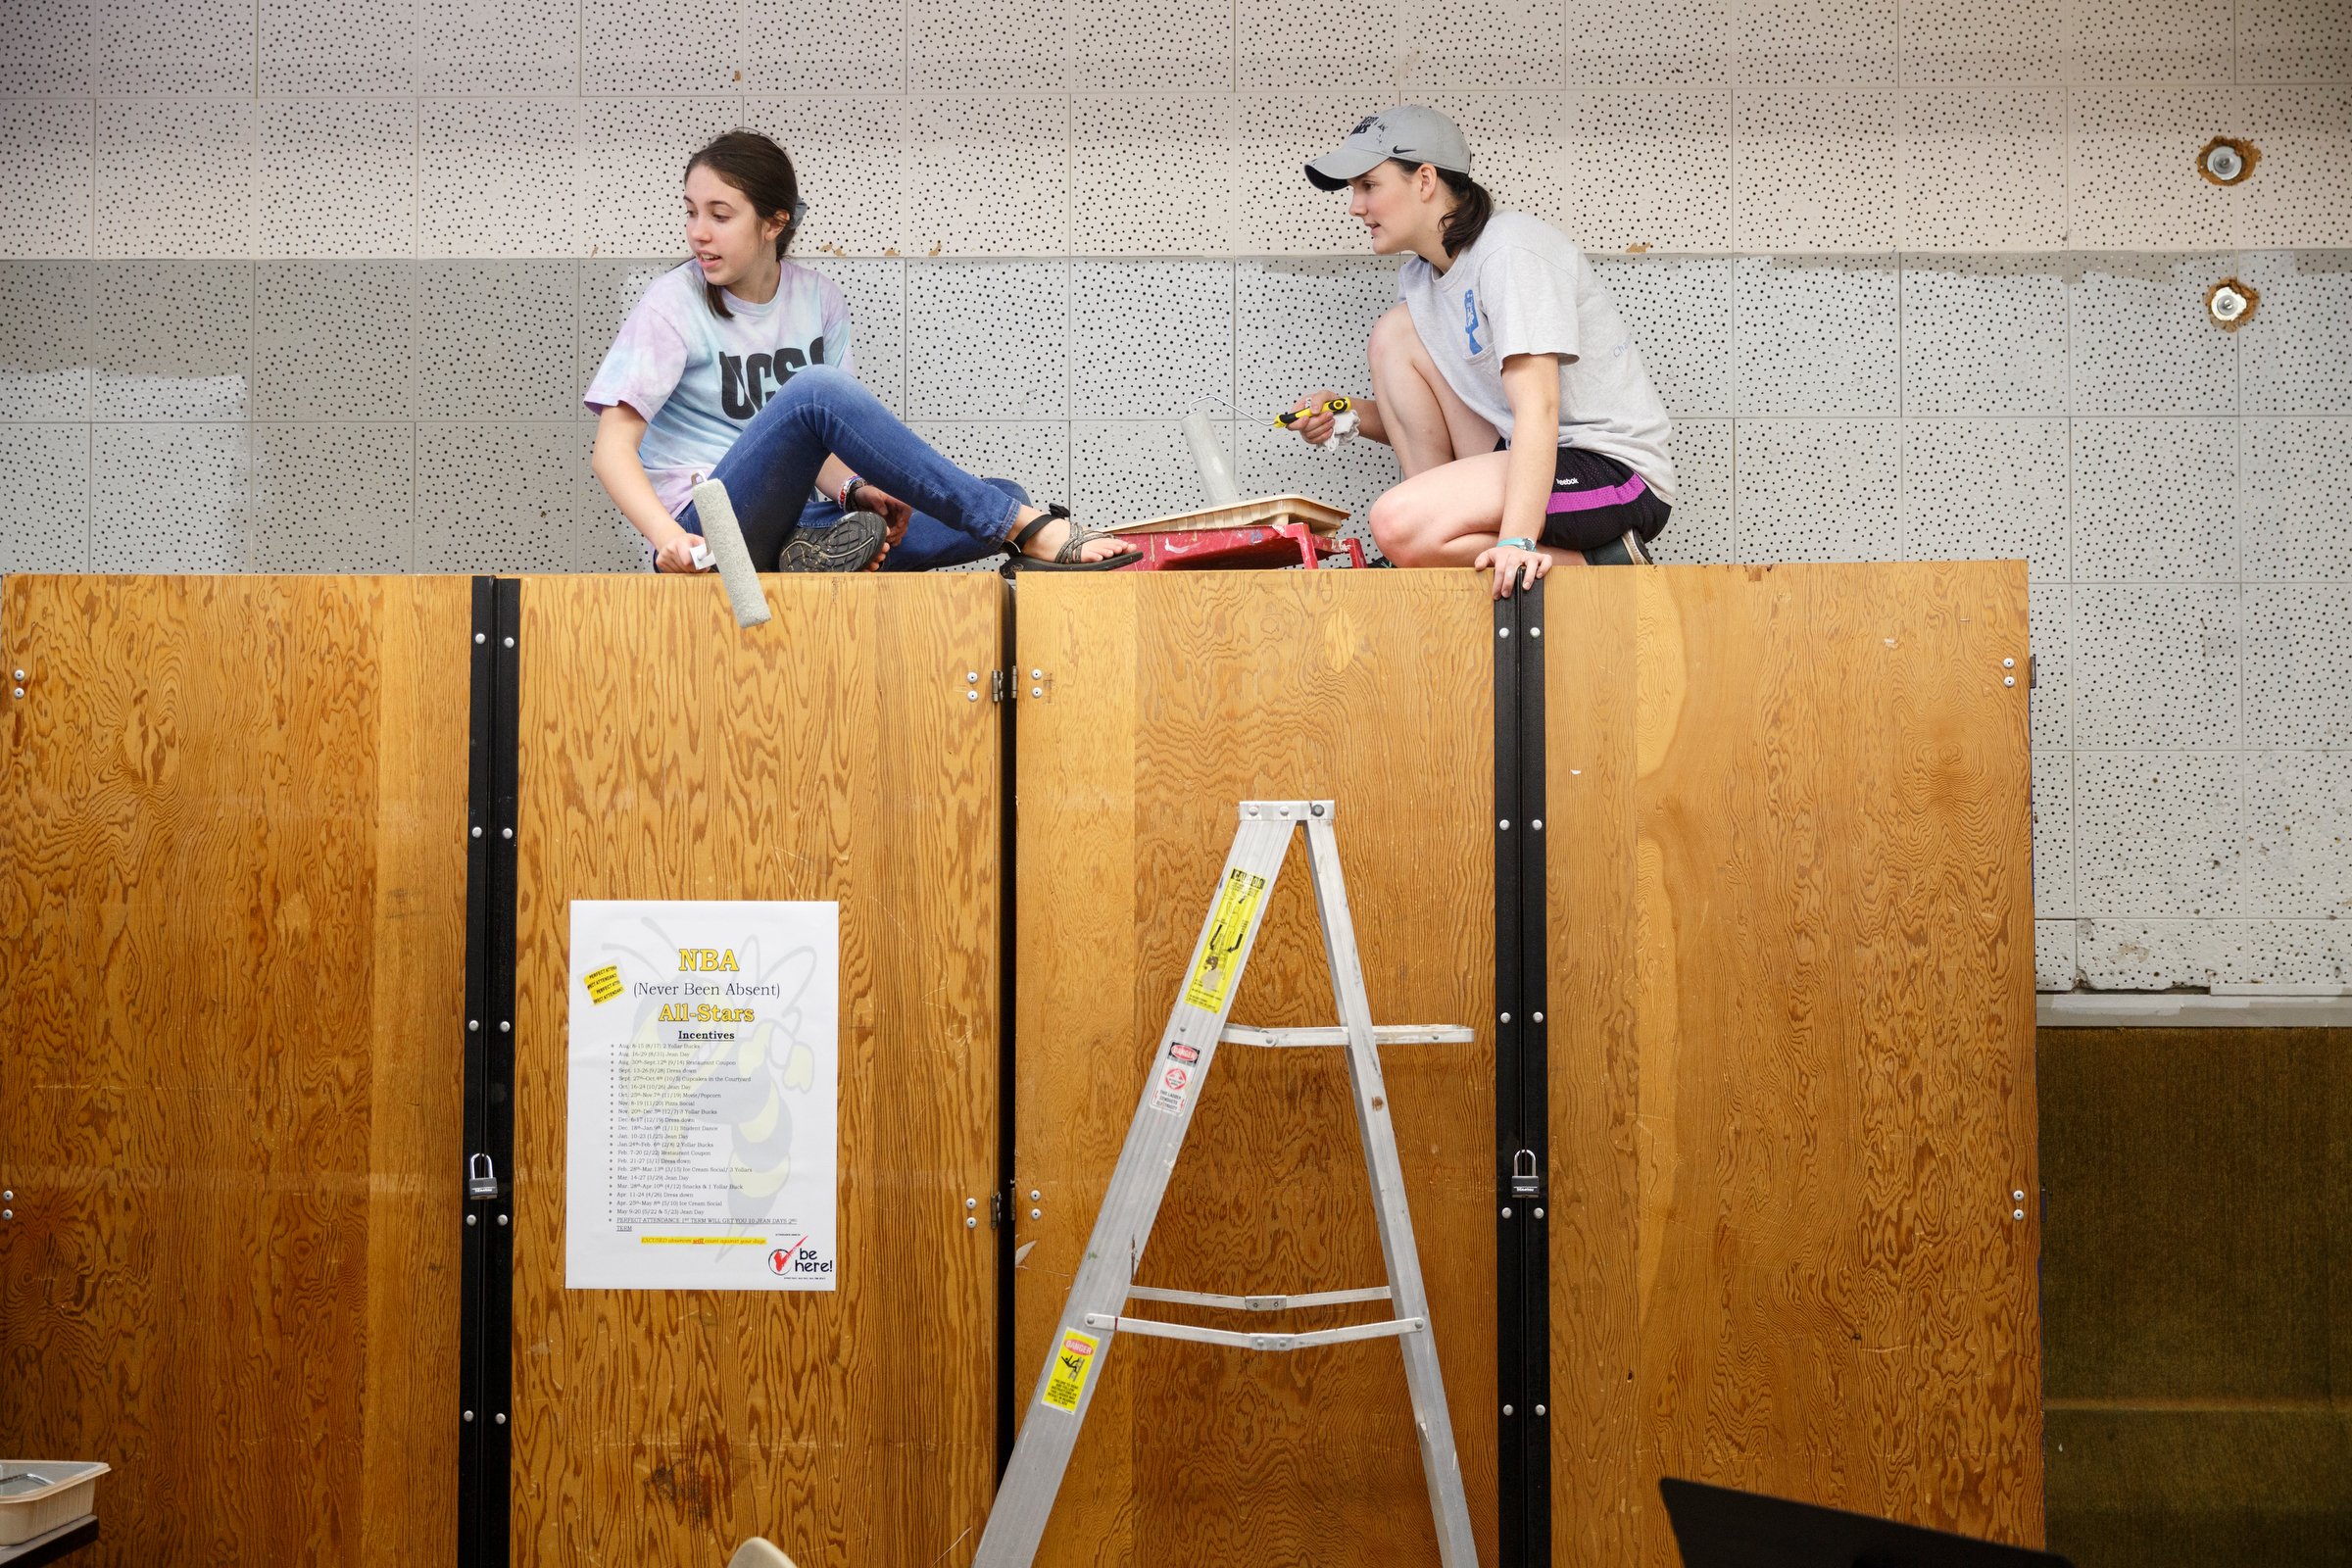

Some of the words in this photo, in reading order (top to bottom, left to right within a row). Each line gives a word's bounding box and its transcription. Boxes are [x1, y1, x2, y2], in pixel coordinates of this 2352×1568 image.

[679, 948, 739, 971] NBA
[633, 982, 679, 999] (Never
[683, 983, 720, 996] Been
[725, 982, 780, 999] Absent)
[658, 1003, 755, 1022] All-Stars
[678, 1030, 735, 1040] Incentives
[799, 1248, 818, 1260] be
[795, 1259, 833, 1272] here!
[1066, 1340, 1093, 1355] DANGER
